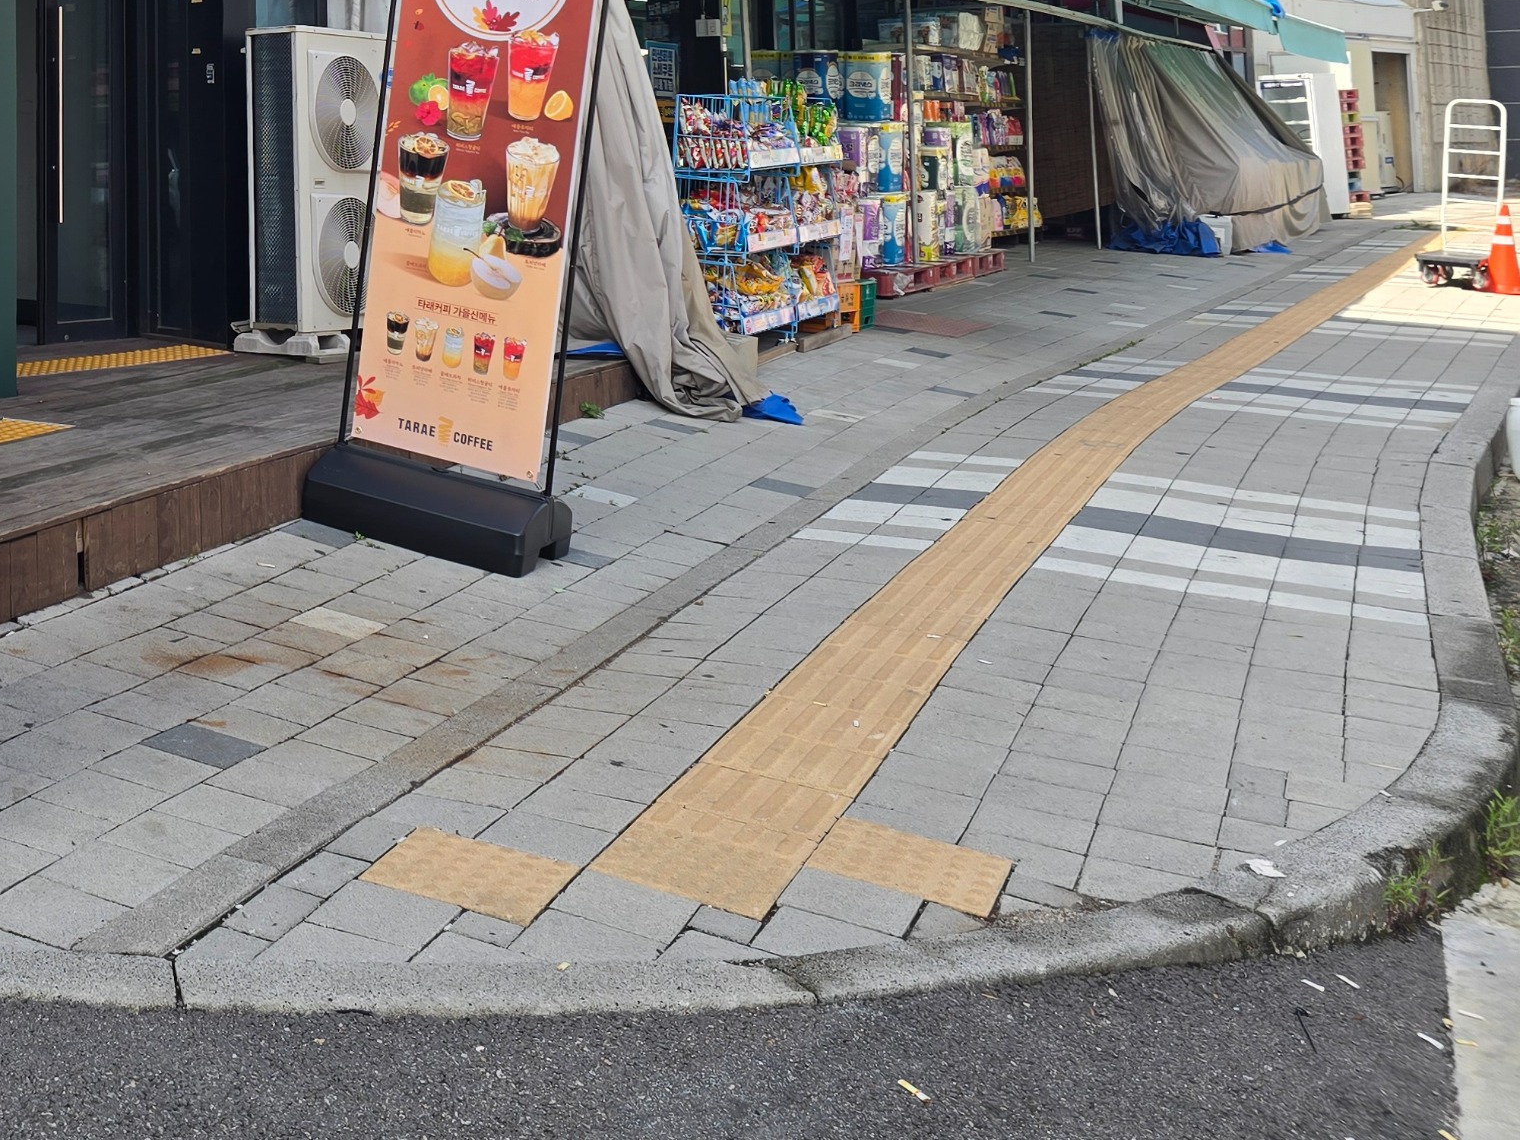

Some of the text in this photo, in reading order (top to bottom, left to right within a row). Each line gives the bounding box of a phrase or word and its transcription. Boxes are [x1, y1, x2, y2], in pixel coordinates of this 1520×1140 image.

[417, 298, 452, 316] 타래커피
[398, 417, 493, 452] TARAE COFFEE
